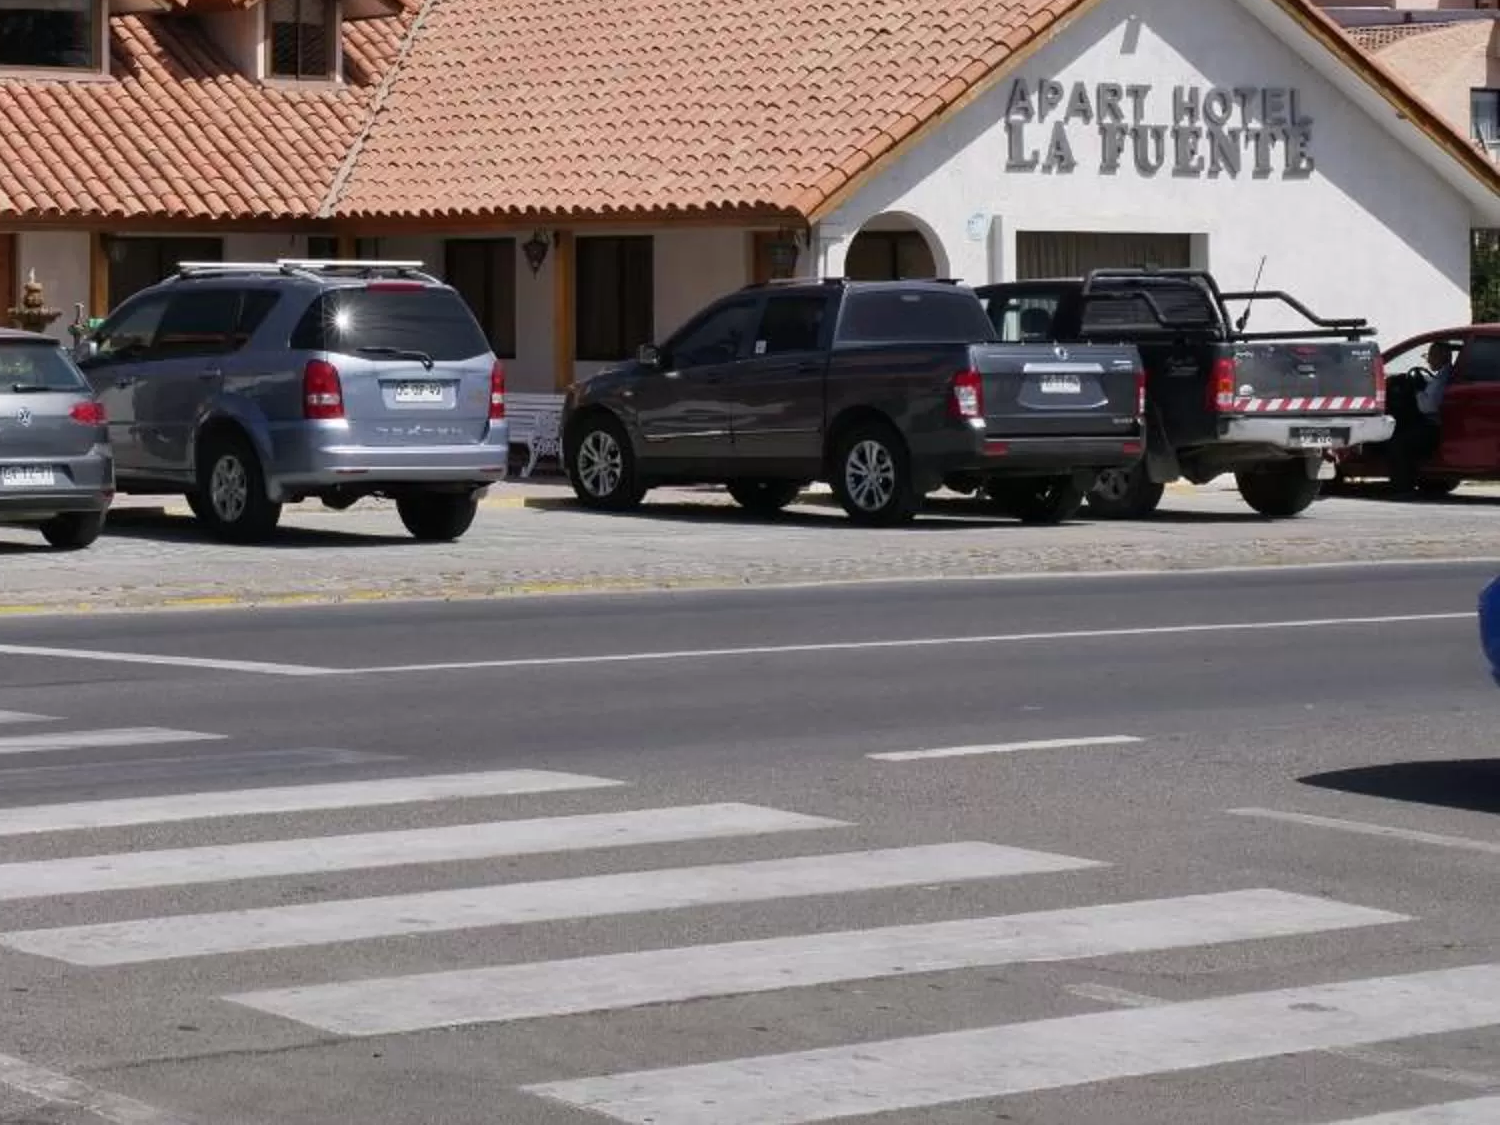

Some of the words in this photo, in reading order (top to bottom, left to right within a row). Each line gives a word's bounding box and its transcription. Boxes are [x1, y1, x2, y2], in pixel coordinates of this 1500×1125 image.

[1004, 78, 1152, 125] APART
[1172, 85, 1314, 127] HOTEL
[1003, 121, 1077, 174] LA
[1099, 124, 1315, 181] FUENTE
